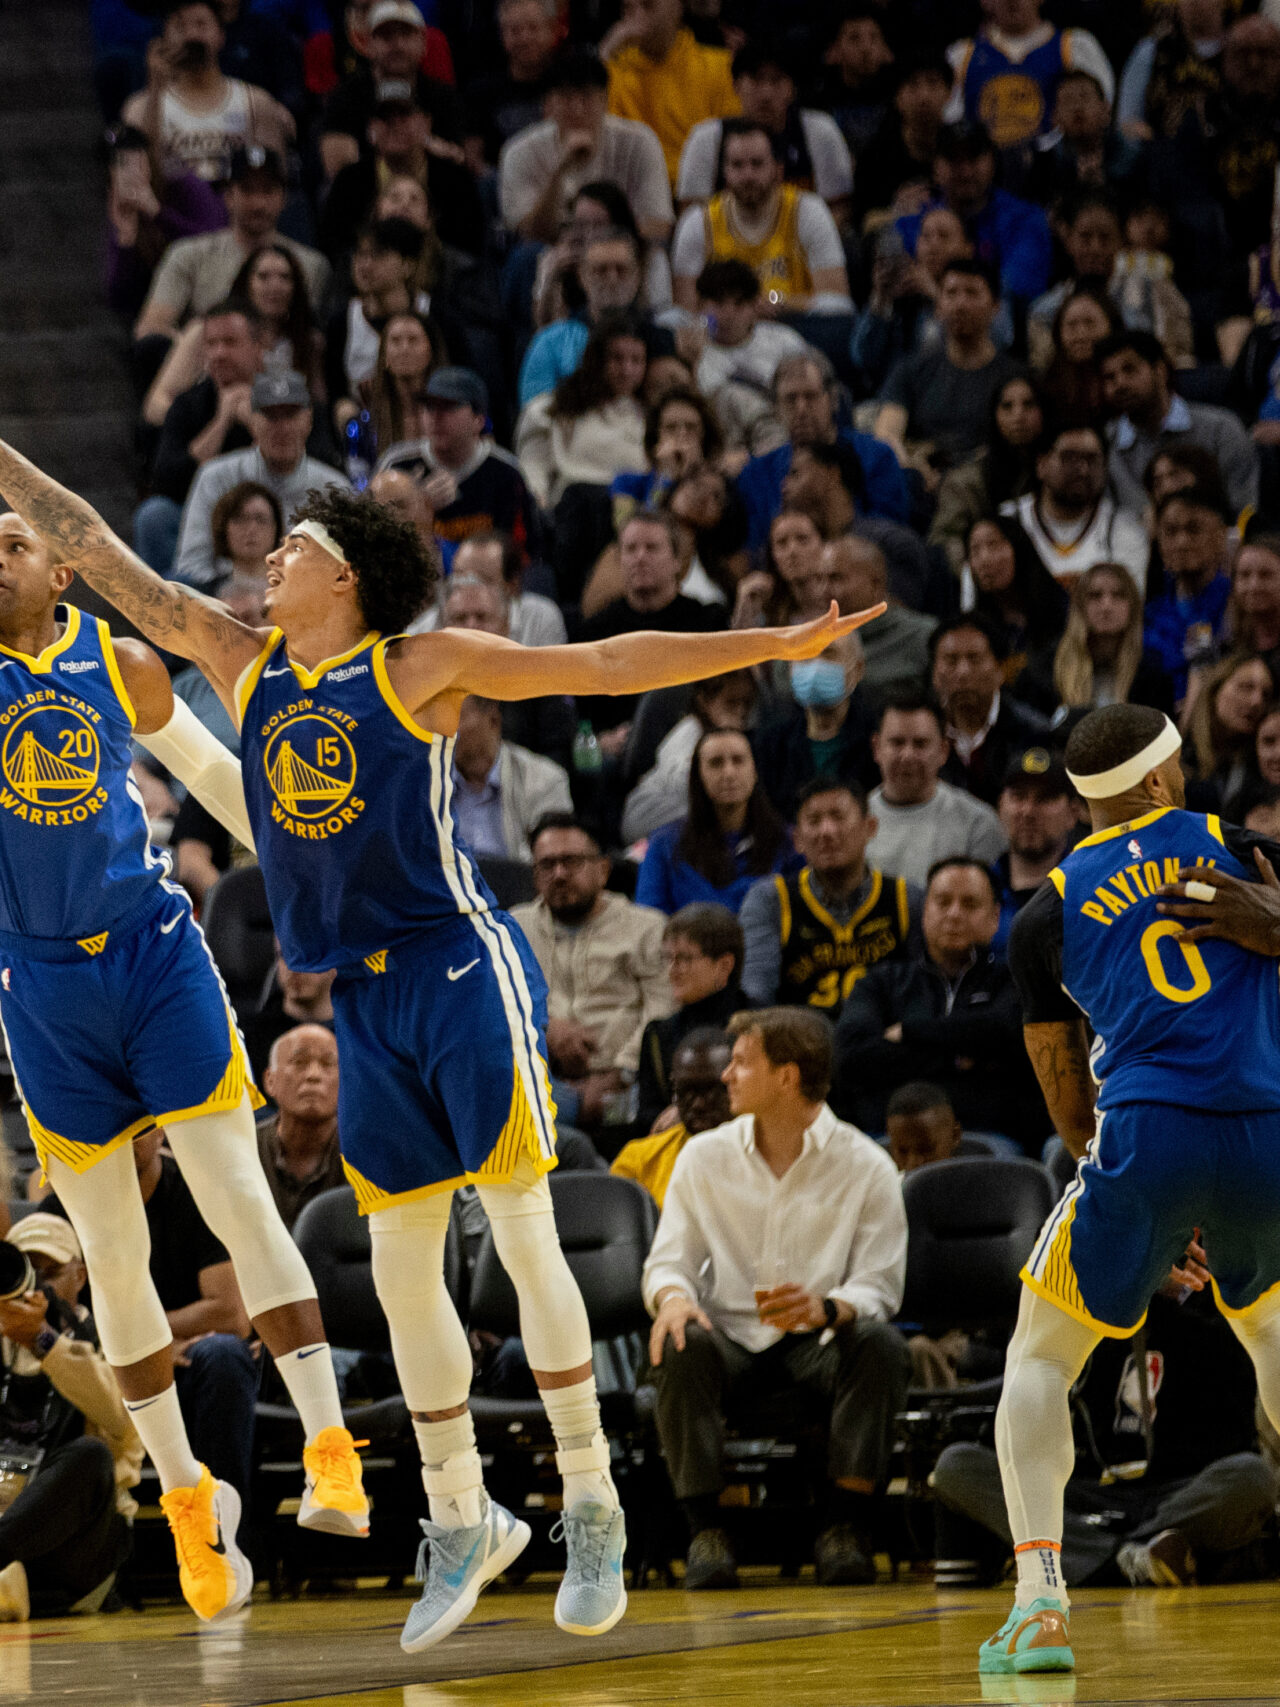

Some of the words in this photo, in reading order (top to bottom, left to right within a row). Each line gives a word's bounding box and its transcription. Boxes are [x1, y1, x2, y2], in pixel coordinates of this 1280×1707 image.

[58, 660, 100, 674] Rakuten
[326, 664, 369, 682] Rakuten
[0, 689, 56, 725] GOLDEN
[261, 698, 314, 736] GOLDEN
[58, 729, 93, 758] 20
[316, 737, 341, 767] 15
[270, 796, 366, 840] WARRIORS
[1080, 857, 1180, 926] PAYTON
[1140, 919, 1212, 1004] 0
